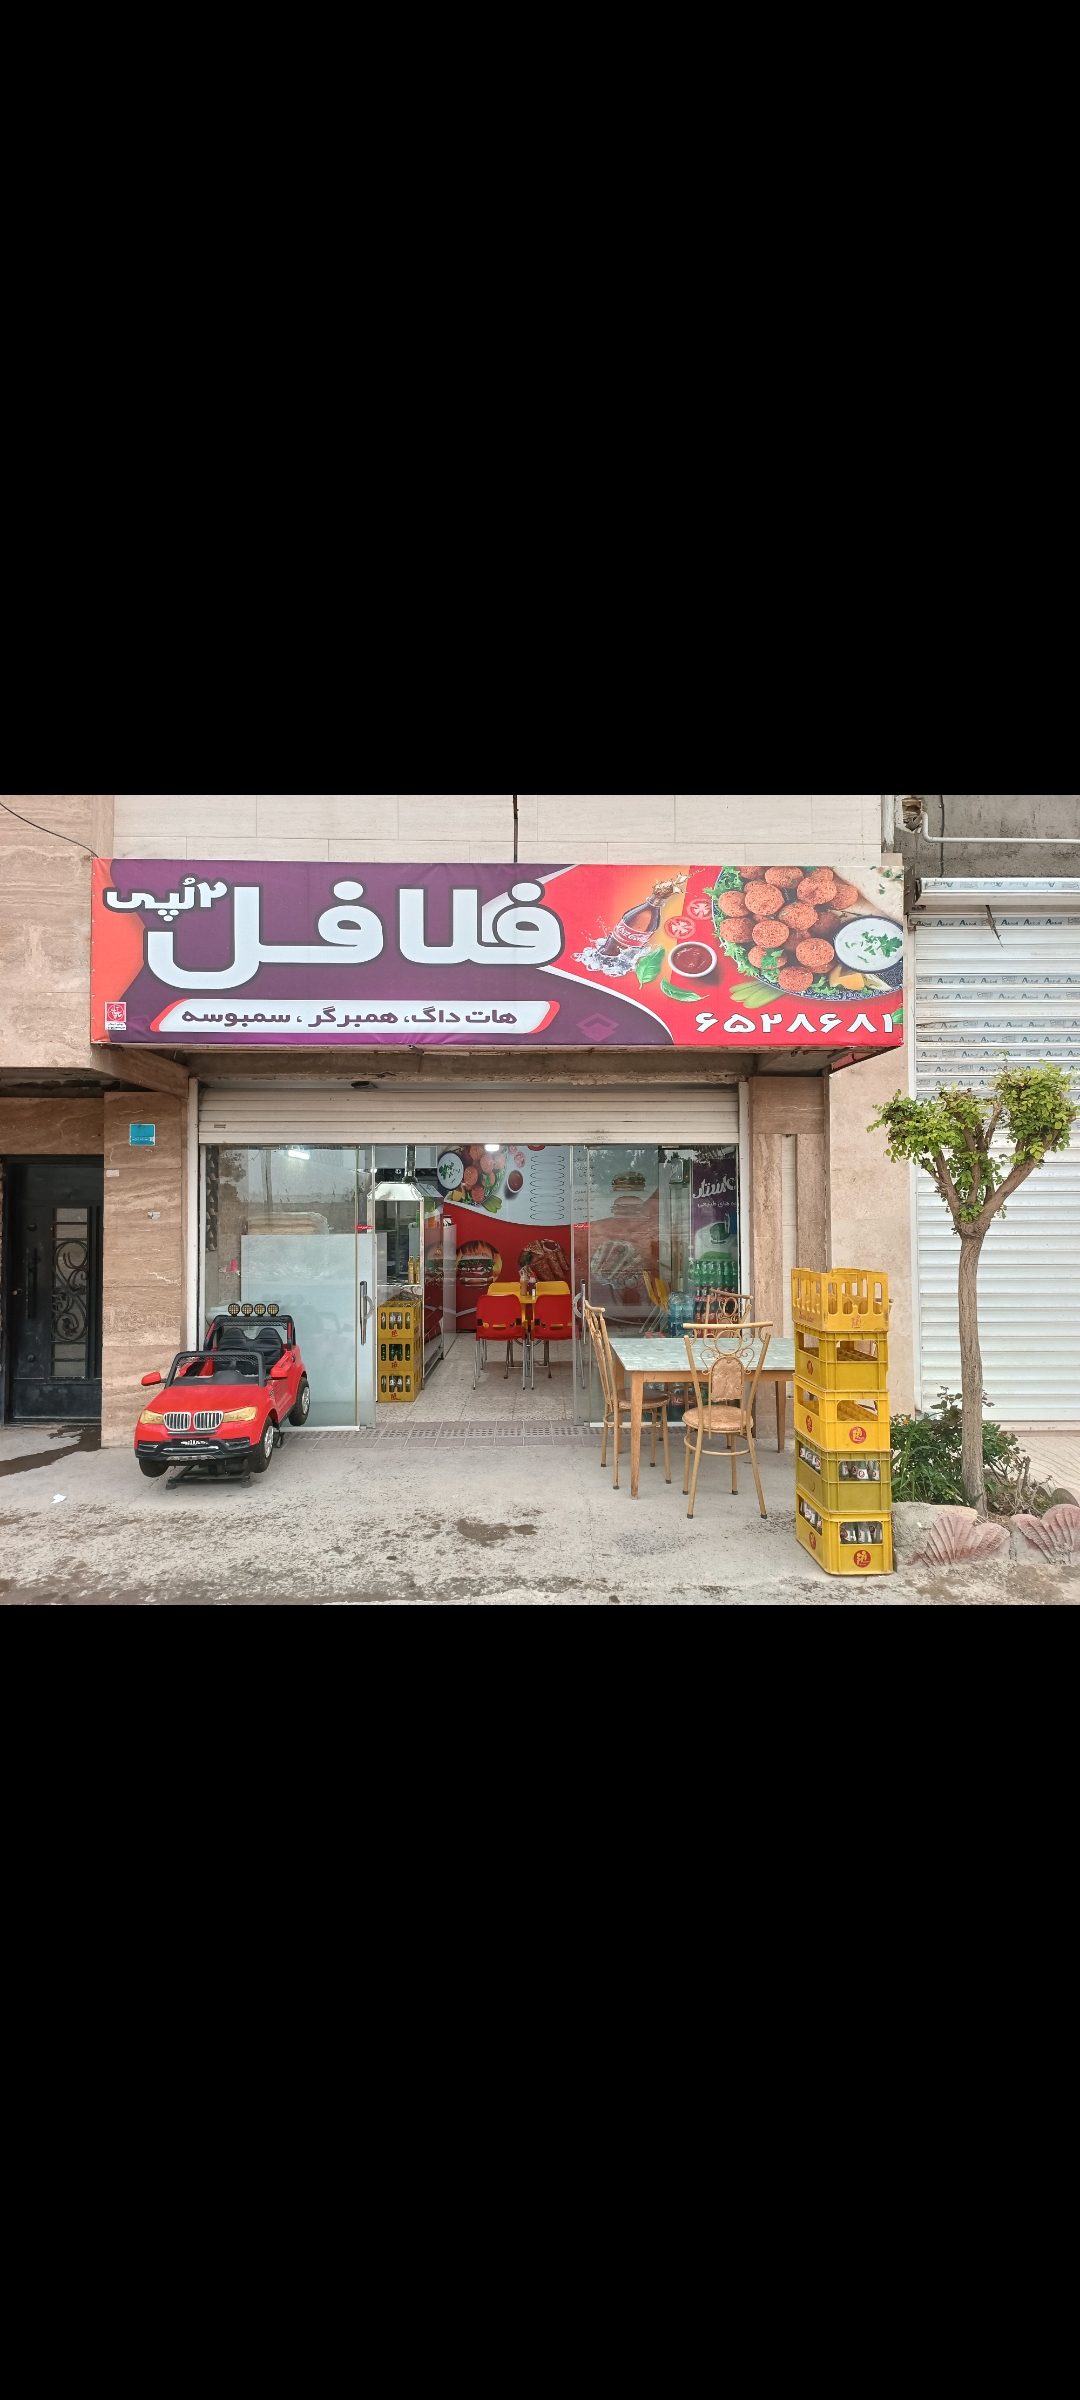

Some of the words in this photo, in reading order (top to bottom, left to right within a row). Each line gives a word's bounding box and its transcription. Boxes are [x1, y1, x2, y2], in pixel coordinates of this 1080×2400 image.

[147, 880, 561, 989] فلافل
[181, 1010, 291, 1028] سمبوسه
[307, 1006, 399, 1028] همبرگر
[465, 1009, 518, 1024] هات
[695, 1012, 894, 1034] ۶۵۲۸۶۸۱
